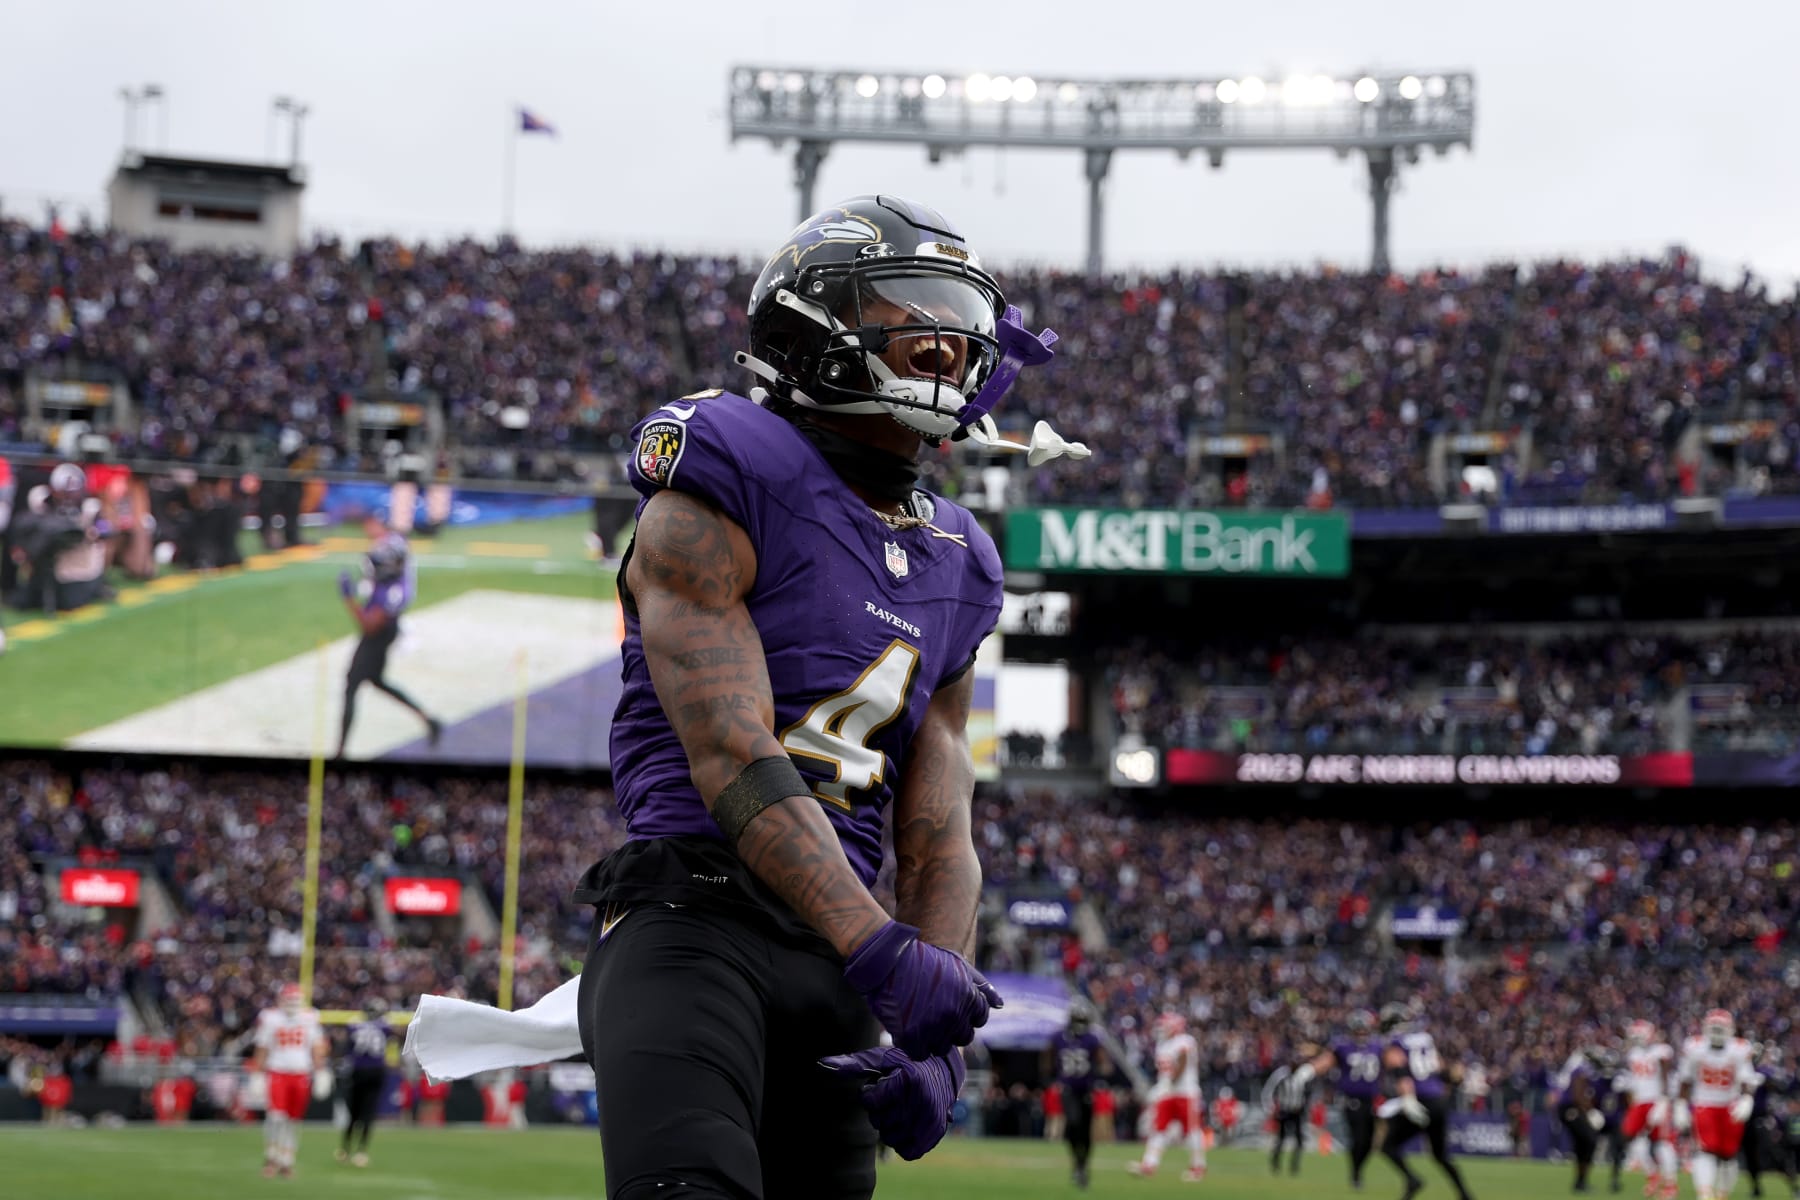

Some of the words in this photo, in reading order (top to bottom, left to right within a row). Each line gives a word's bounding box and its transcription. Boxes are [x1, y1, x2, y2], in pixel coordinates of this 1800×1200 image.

[645, 425, 679, 437] RAVENS
[1038, 508, 1181, 571] M&T
[1181, 510, 1318, 574] Bank
[864, 600, 922, 638] RAVENS
[778, 637, 921, 812] 4
[1236, 752, 1303, 783] 2023
[1304, 753, 1362, 784] AFC
[1361, 753, 1457, 784] NORTH
[1457, 753, 1621, 784] CHAMPIONS
